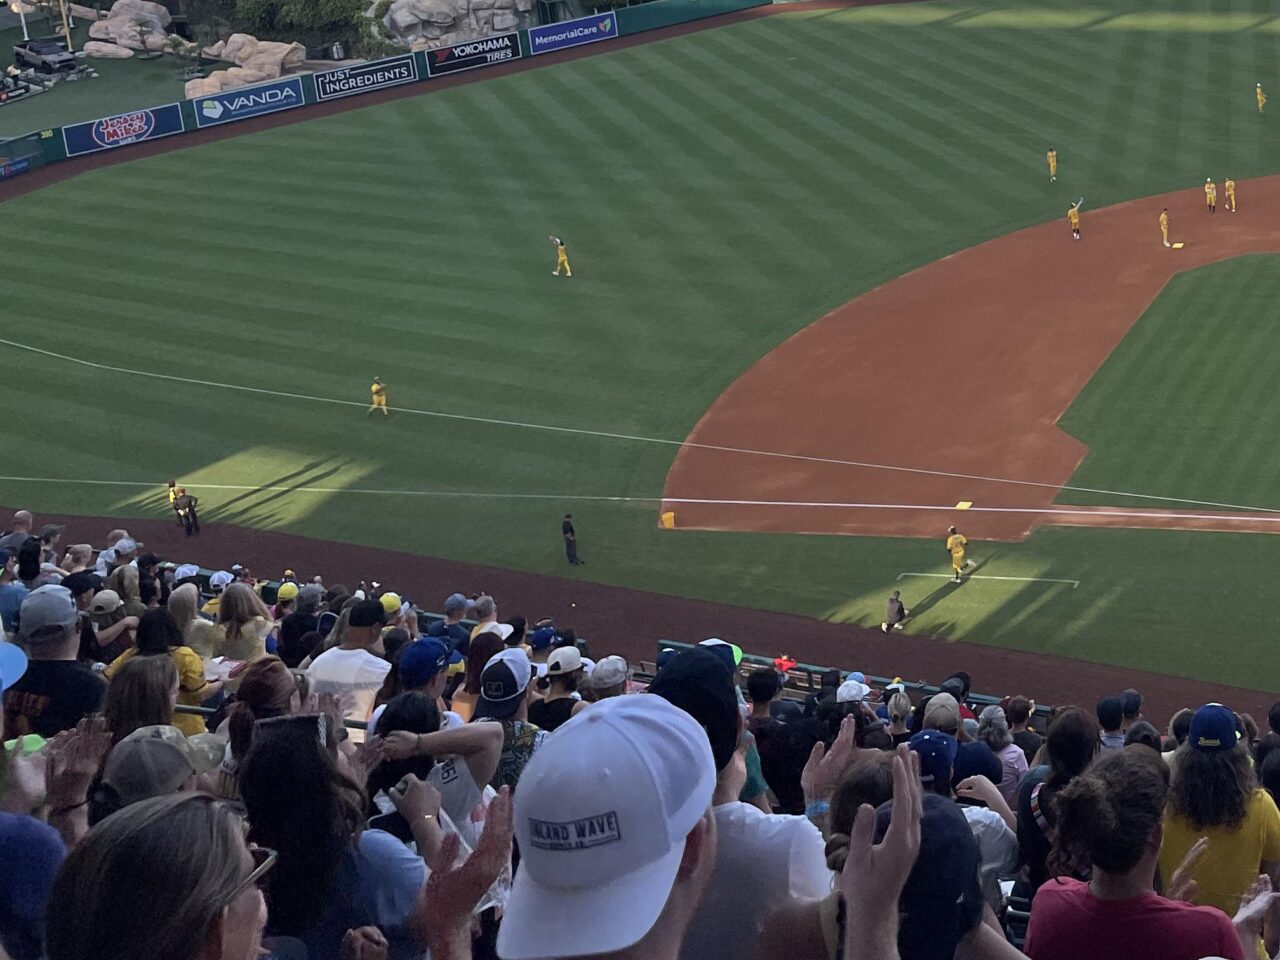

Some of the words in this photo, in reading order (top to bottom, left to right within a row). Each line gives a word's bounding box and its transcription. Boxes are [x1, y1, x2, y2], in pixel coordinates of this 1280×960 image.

[535, 25, 598, 46] MemorialCare
[452, 37, 512, 58] YOKOHAMA
[486, 49, 513, 63] TIRES
[324, 69, 350, 83] JUST
[326, 67, 409, 94] INGREDIENTS
[223, 87, 296, 111] VANDA
[100, 112, 147, 132] Jersey
[574, 814, 616, 839] WAVE
